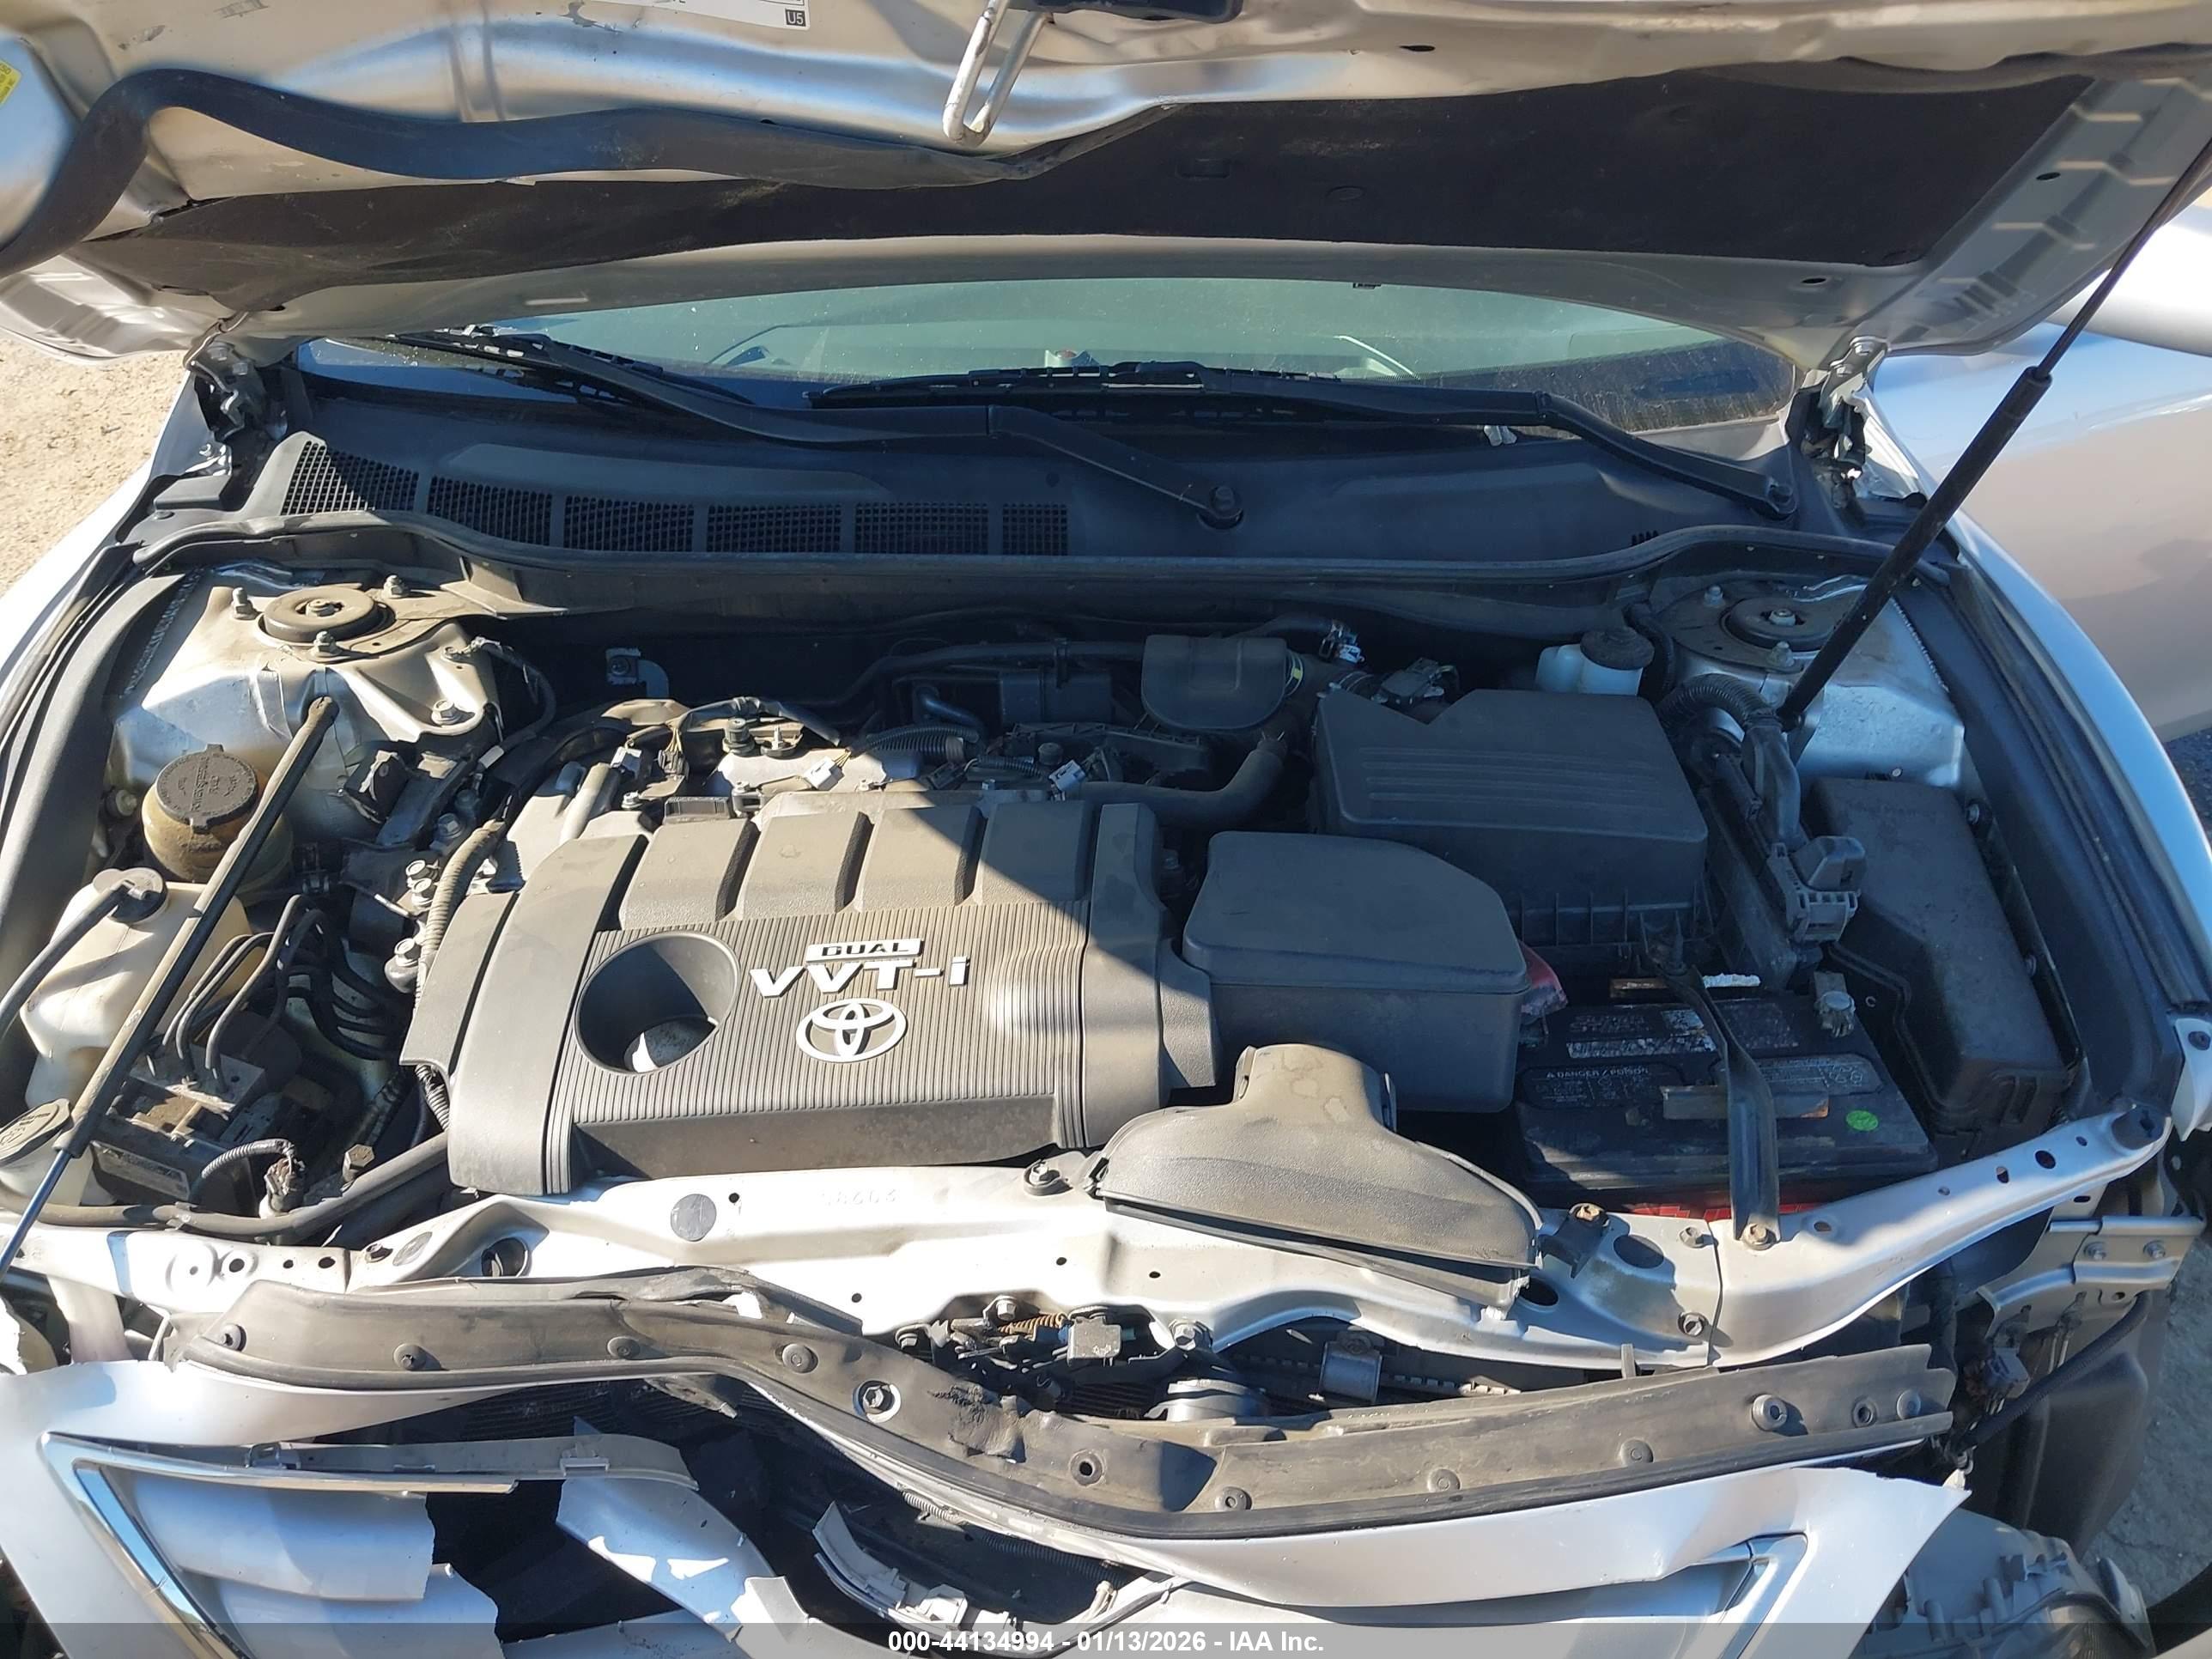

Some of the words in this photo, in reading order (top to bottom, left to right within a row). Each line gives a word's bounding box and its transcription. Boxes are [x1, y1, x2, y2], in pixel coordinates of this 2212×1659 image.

[787, 10, 804, 25] U5
[821, 941, 910, 957] DUAL
[750, 955, 970, 999] VVT-i
